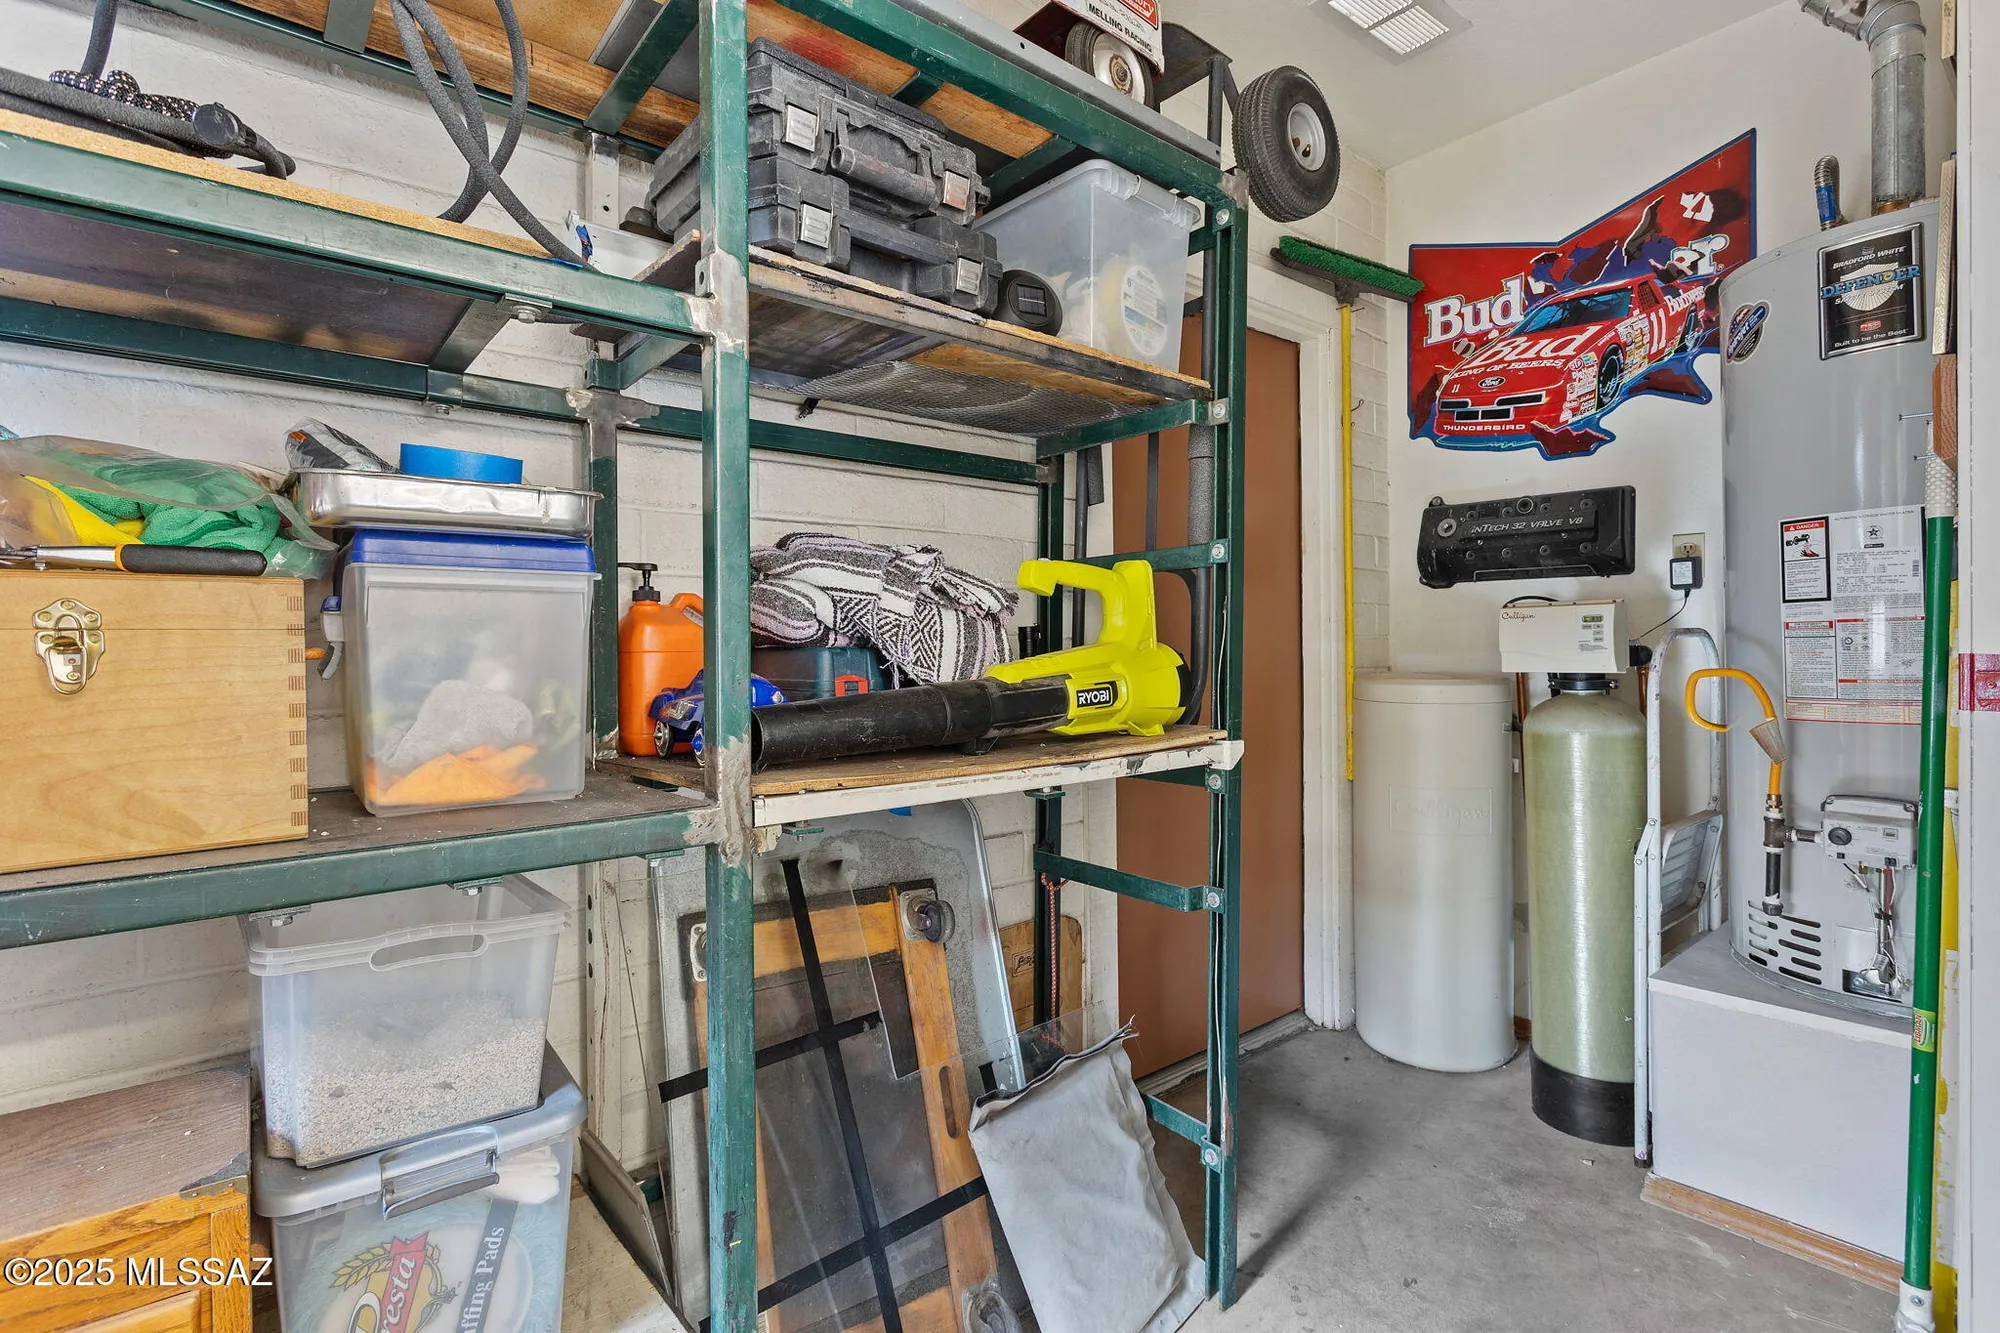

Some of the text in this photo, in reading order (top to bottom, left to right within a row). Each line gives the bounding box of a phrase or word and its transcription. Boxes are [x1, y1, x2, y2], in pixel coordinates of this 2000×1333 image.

[1088, 4, 1123, 32] MELLING
[1124, 27, 1153, 53] RACING
[1833, 253, 1876, 270] BRADFORD
[1877, 245, 1907, 258] WHITE
[1820, 264, 1921, 300] DEFENDER
[1649, 307, 1667, 355] 11
[1834, 340, 1850, 348] Built
[1861, 334, 1871, 342] be
[1873, 331, 1887, 340] the
[1888, 328, 1907, 337] Best
[1461, 324, 1603, 369] Bud
[1486, 363, 1508, 372] OF
[1506, 358, 1565, 370] BEERS
[1511, 522, 1526, 530] 32
[1530, 518, 1563, 529] VALVE
[1569, 516, 1583, 526] V8
[1501, 611, 1536, 623] Culligan
[1077, 689, 1110, 705] RYOBI
[475, 1227, 505, 1275] Pads
